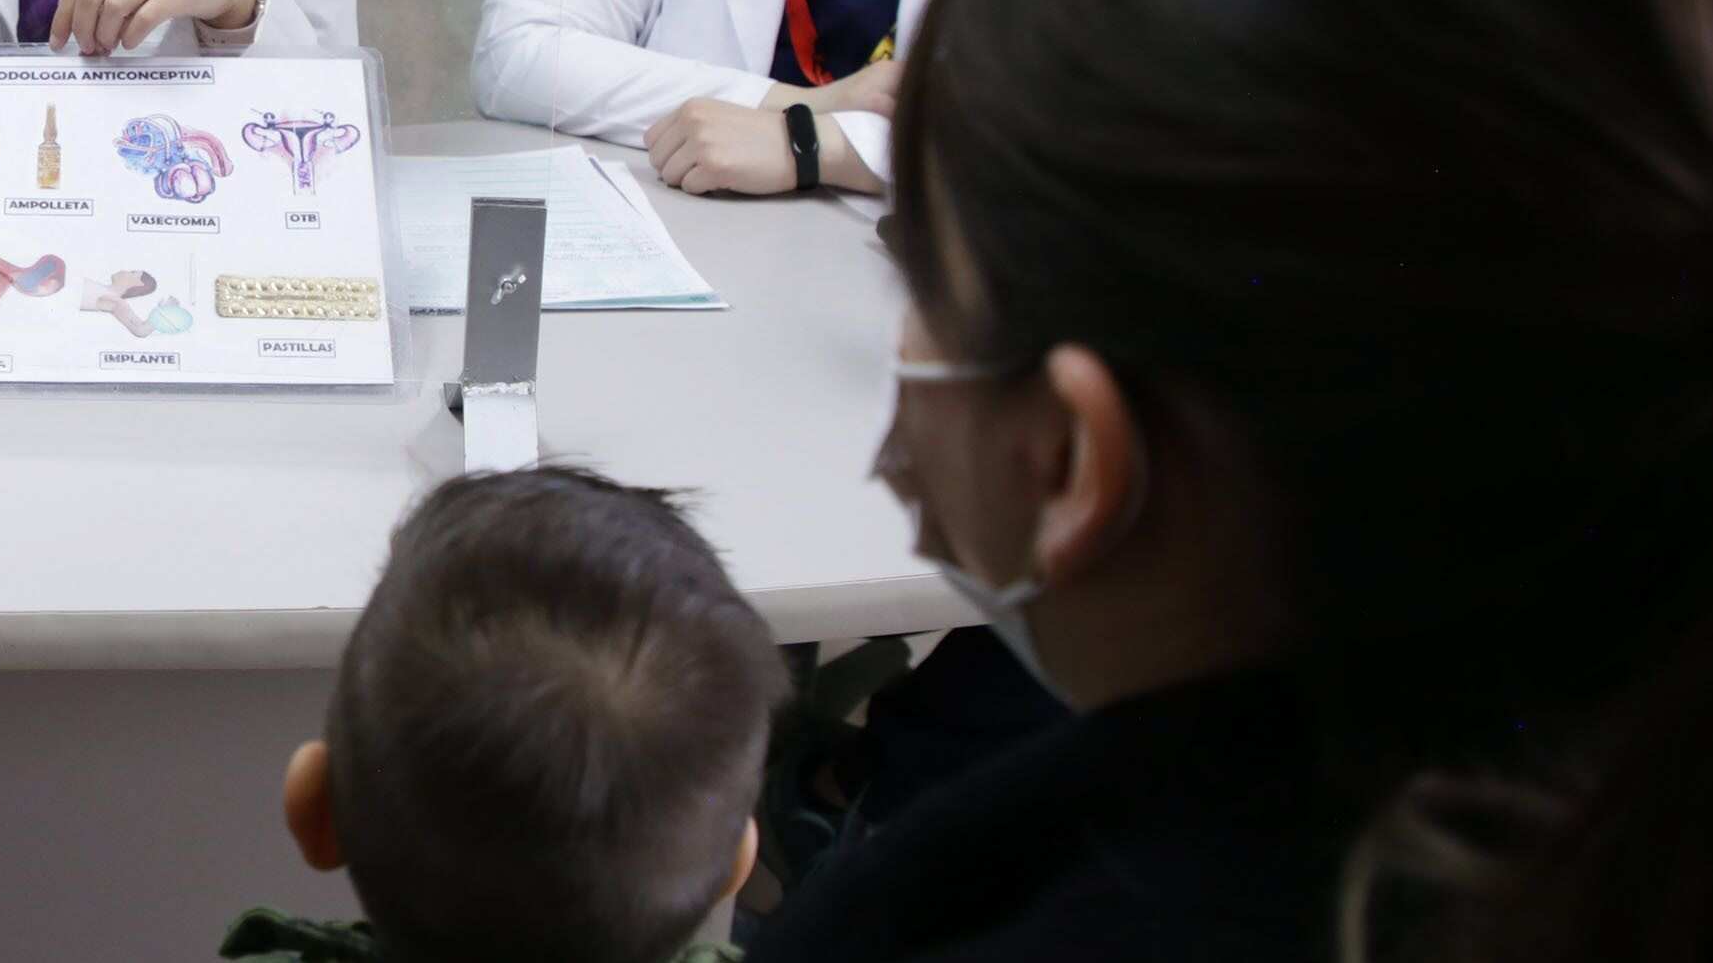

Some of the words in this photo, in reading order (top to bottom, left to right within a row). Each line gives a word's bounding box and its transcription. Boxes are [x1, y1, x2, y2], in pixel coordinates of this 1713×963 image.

[81, 69, 212, 81] ANTICONCEPTIVA
[9, 200, 89, 211] AMPOLLETA
[131, 215, 217, 228] VASECTOMIA
[289, 213, 317, 224] OTB
[263, 342, 334, 353] PASTILLAS
[104, 353, 176, 365] IMPLANTE
